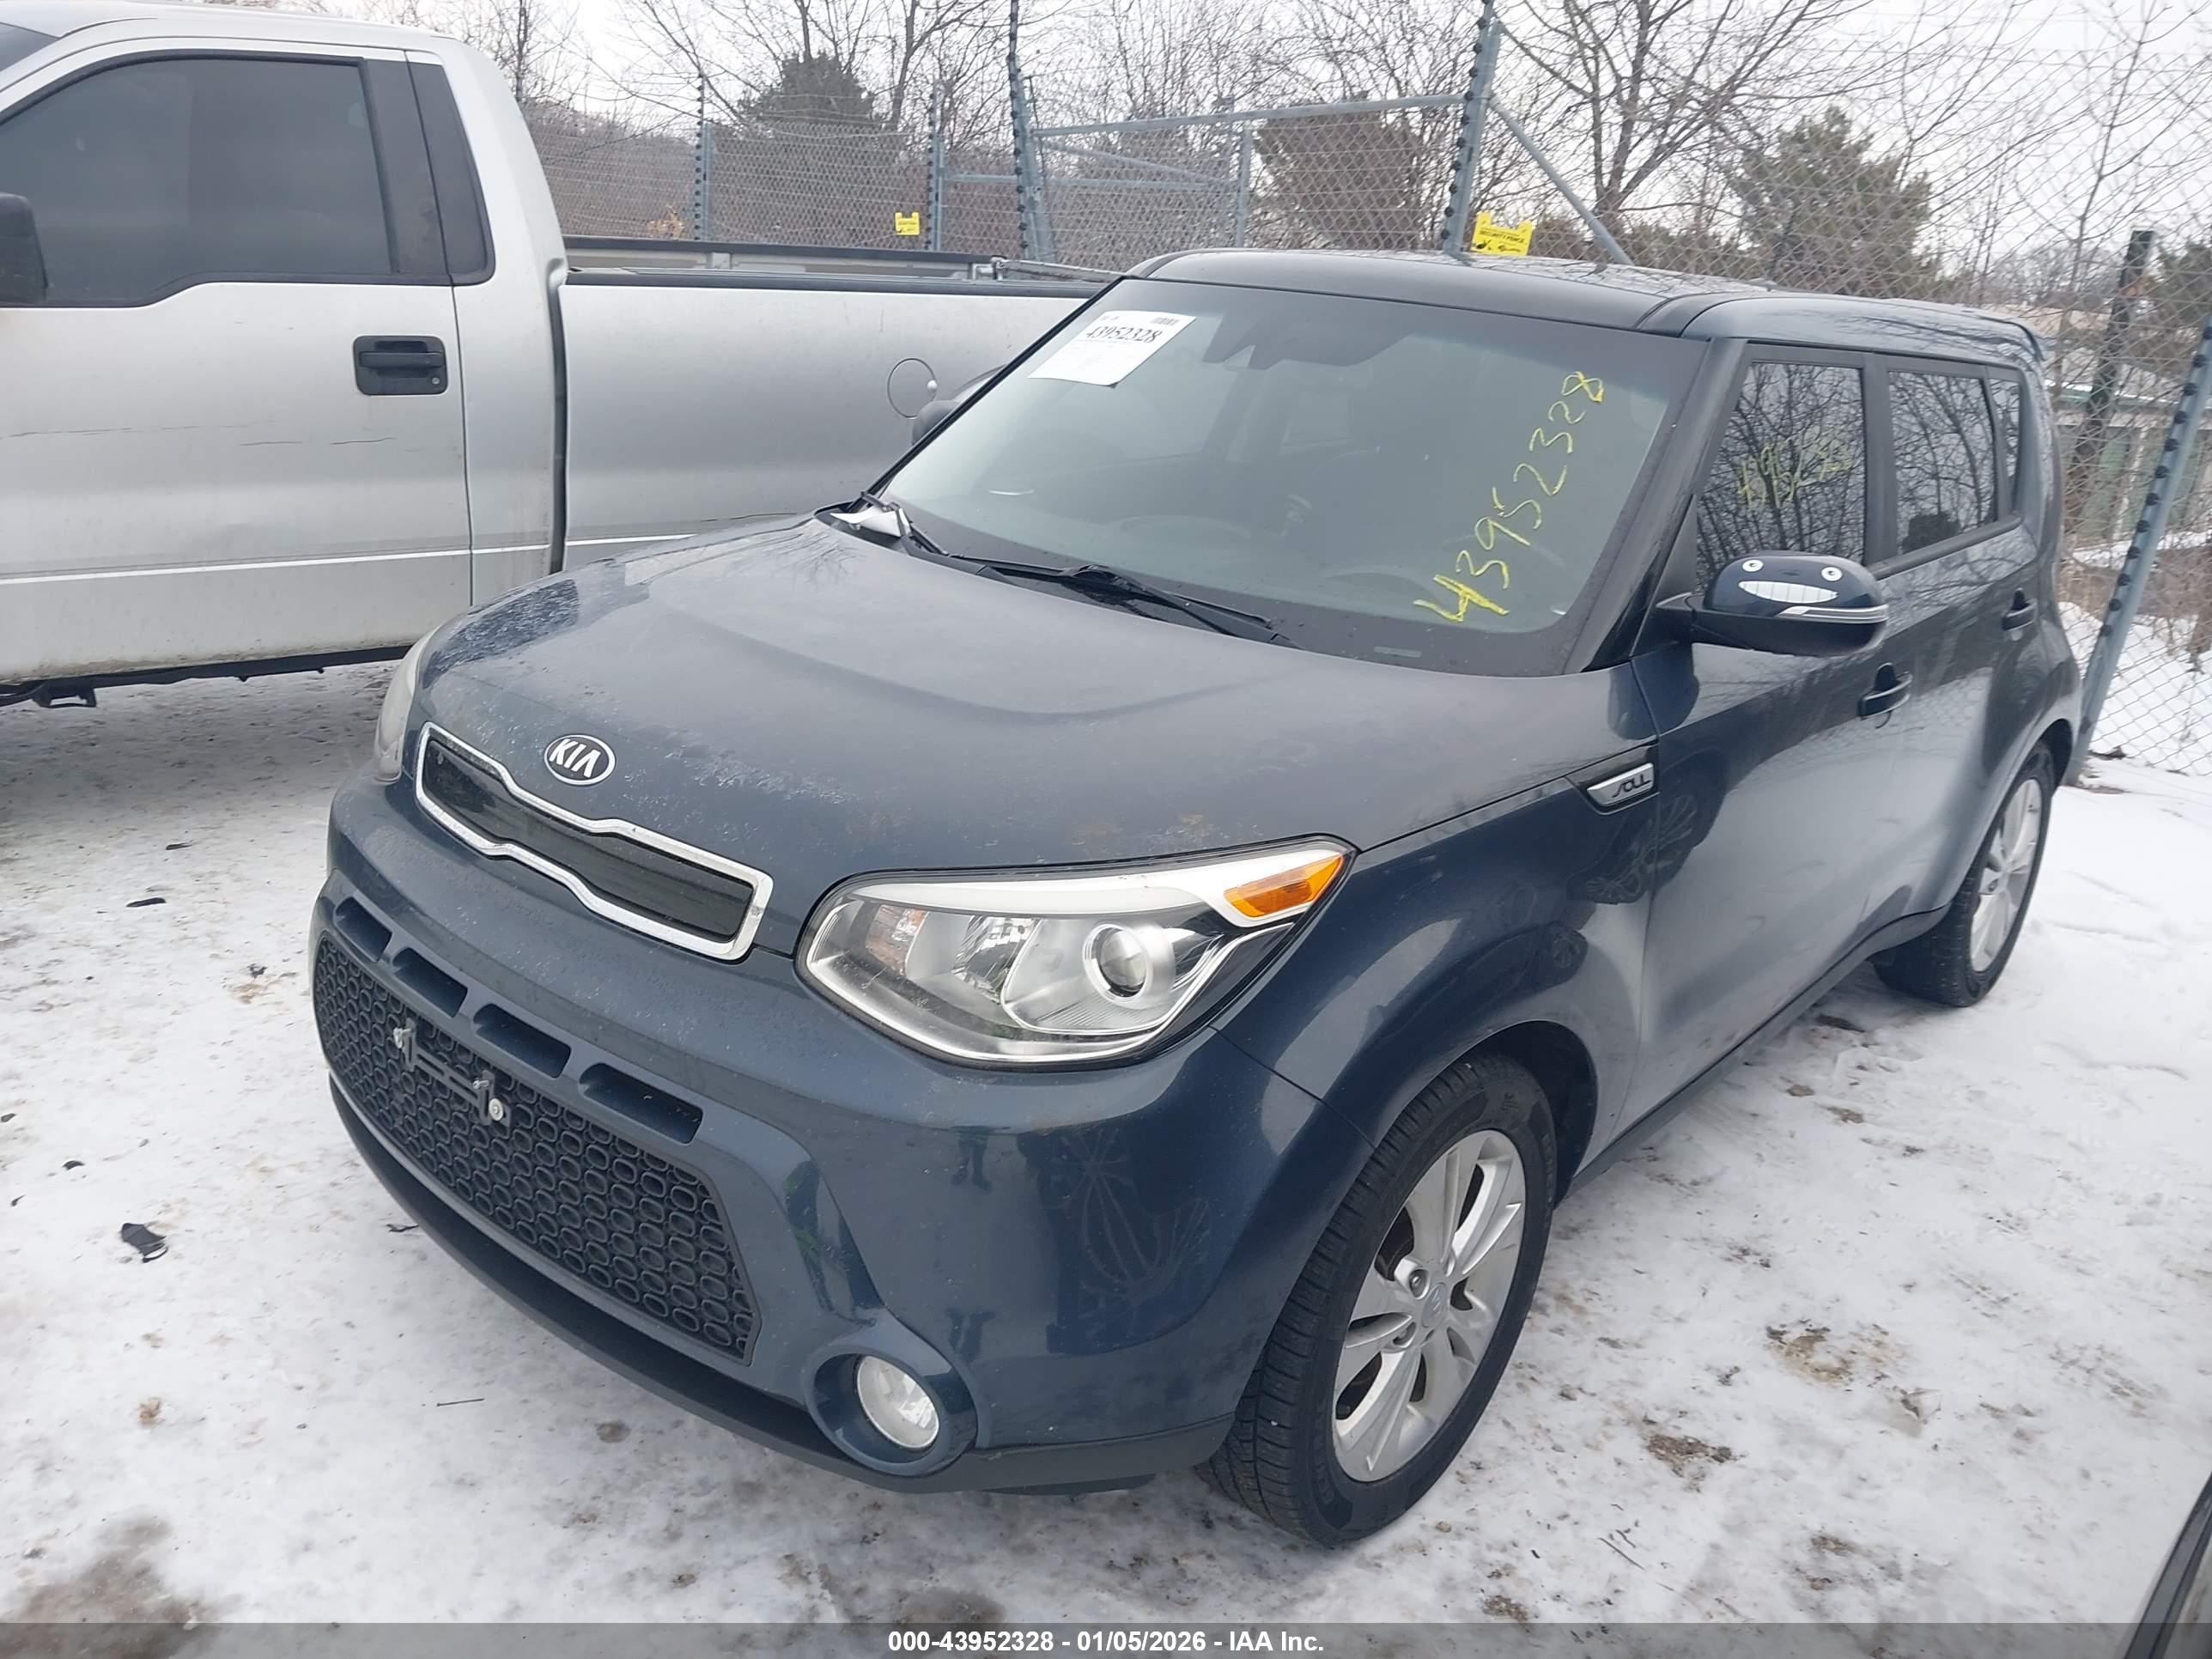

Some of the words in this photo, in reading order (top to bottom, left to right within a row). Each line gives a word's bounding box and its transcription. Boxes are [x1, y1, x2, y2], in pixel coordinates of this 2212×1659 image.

[1086, 326, 1164, 343] 43952328
[1413, 370, 1605, 623] 43952328
[549, 738, 602, 778] KIA
